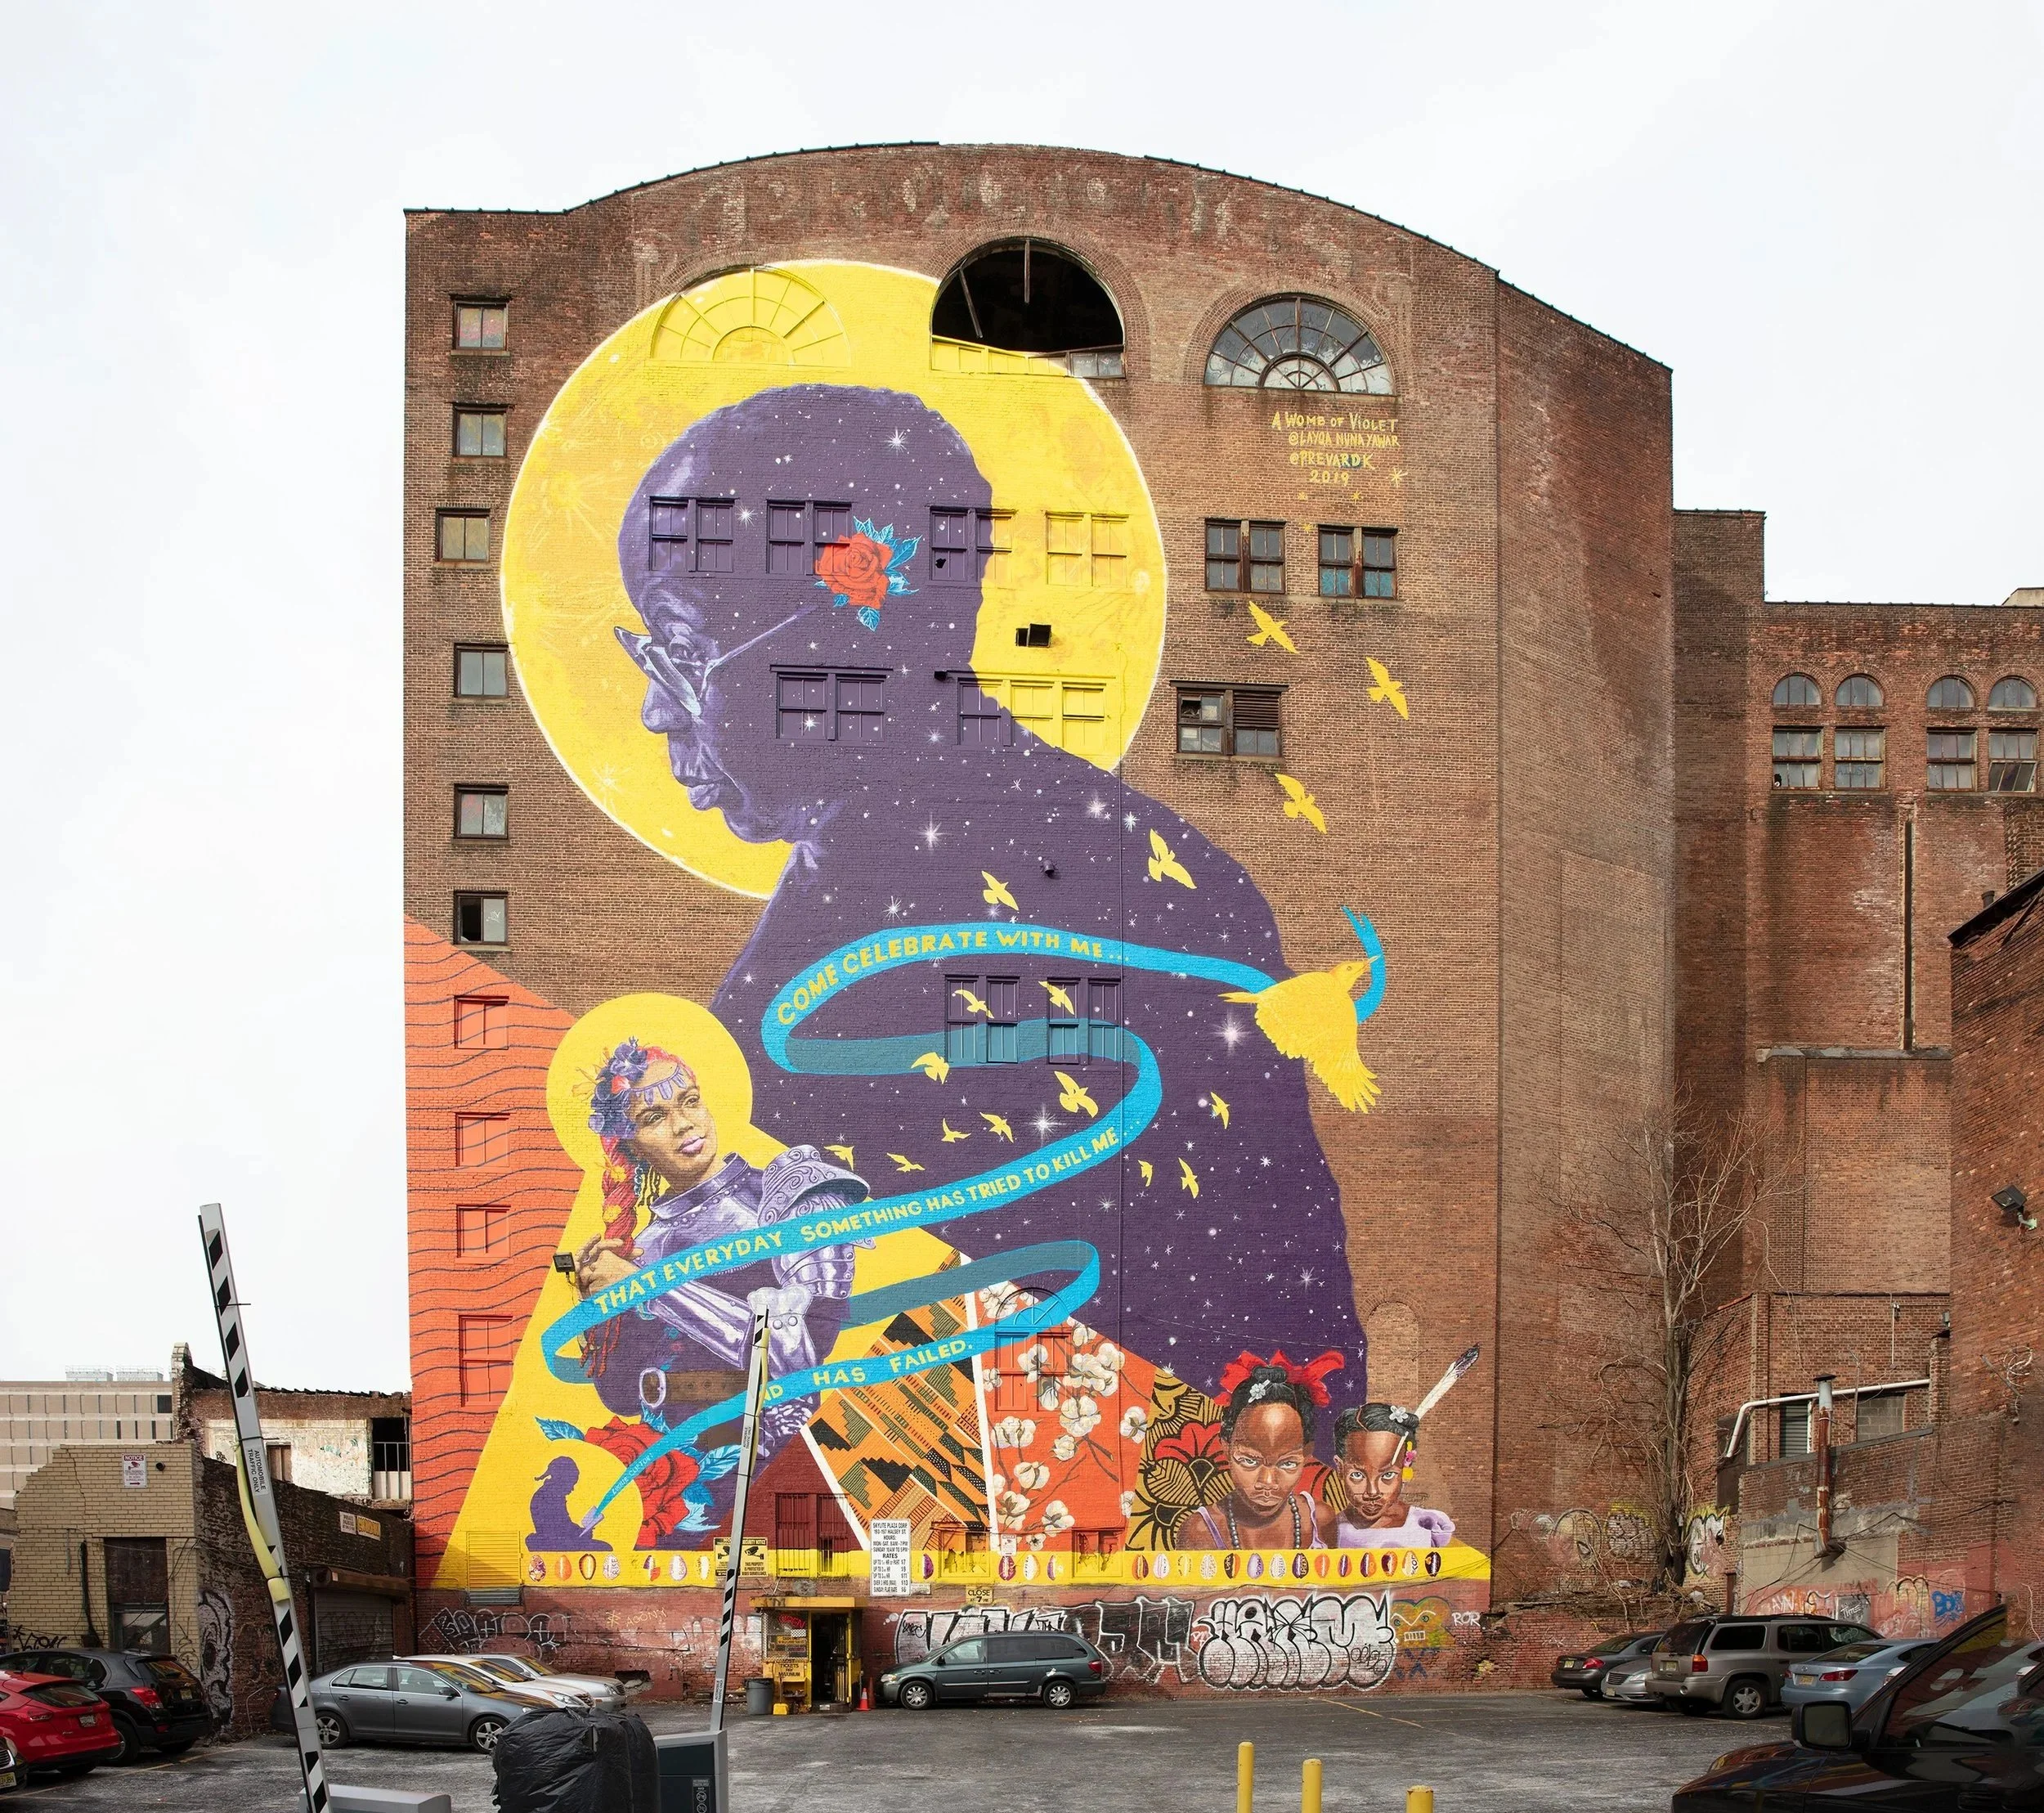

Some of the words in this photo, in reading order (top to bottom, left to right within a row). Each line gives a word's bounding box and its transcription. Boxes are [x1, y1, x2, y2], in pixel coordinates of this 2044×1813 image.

[1271, 411, 1281, 431] A
[1285, 412, 1325, 428] WOMB
[1330, 417, 1345, 428] OF
[1309, 469, 1350, 487] 2019
[778, 963, 839, 1025] COME
[843, 931, 987, 973] CELEBRATE
[996, 931, 1060, 948] WITH
[594, 1270, 657, 1315] THAT
[663, 1231, 782, 1282] EVERYDAY
[800, 1201, 922, 1242] SOMETHING
[926, 1190, 965, 1212] HAS
[966, 1174, 1021, 1201] TRIED
[1023, 1163, 1050, 1183] TO
[1051, 1146, 1092, 1172] KILL
[814, 1366, 867, 1386] HAS
[890, 1339, 973, 1373] FAILED.
[248, 1449, 257, 1475] TRAFFIC
[254, 1450, 266, 1490] AUTOMOBILE
